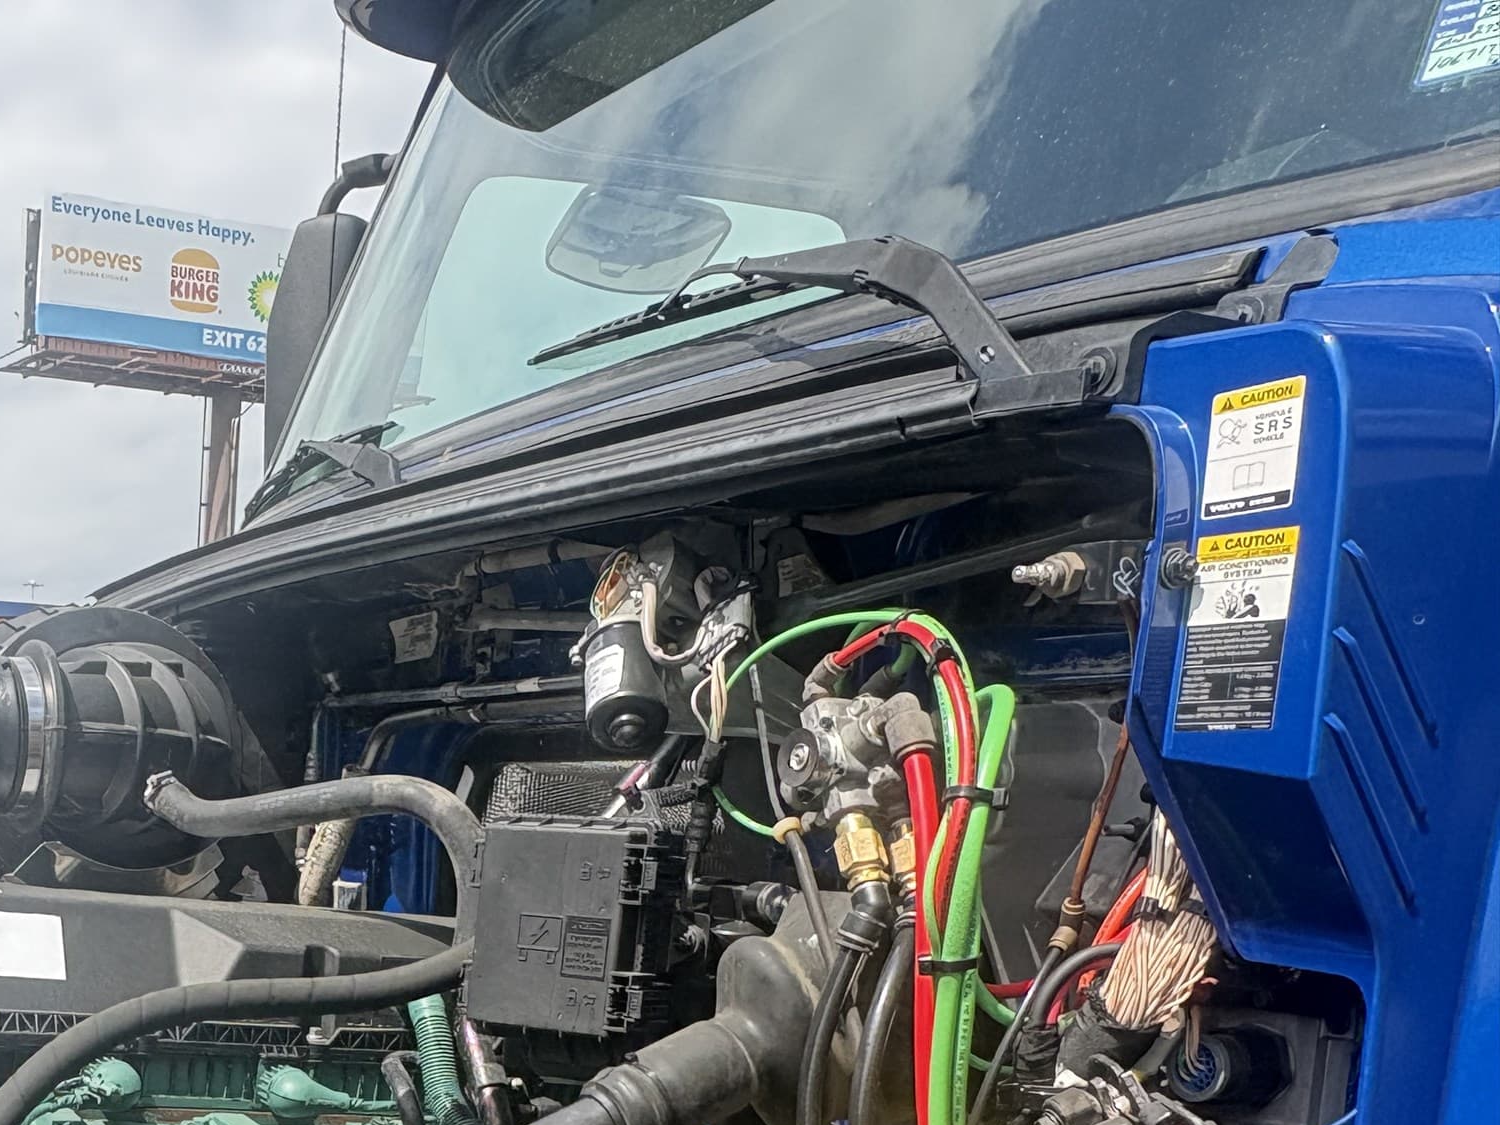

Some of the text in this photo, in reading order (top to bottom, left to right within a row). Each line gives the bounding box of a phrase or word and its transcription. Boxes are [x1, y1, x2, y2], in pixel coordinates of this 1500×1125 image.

[51, 195, 255, 247] Everyone Leaves Happy.
[171, 264, 220, 284] BURGER
[169, 279, 219, 303] KING
[202, 328, 245, 349] EXIT
[1240, 384, 1294, 406] CAUTION
[1224, 532, 1285, 551] CAUTION
